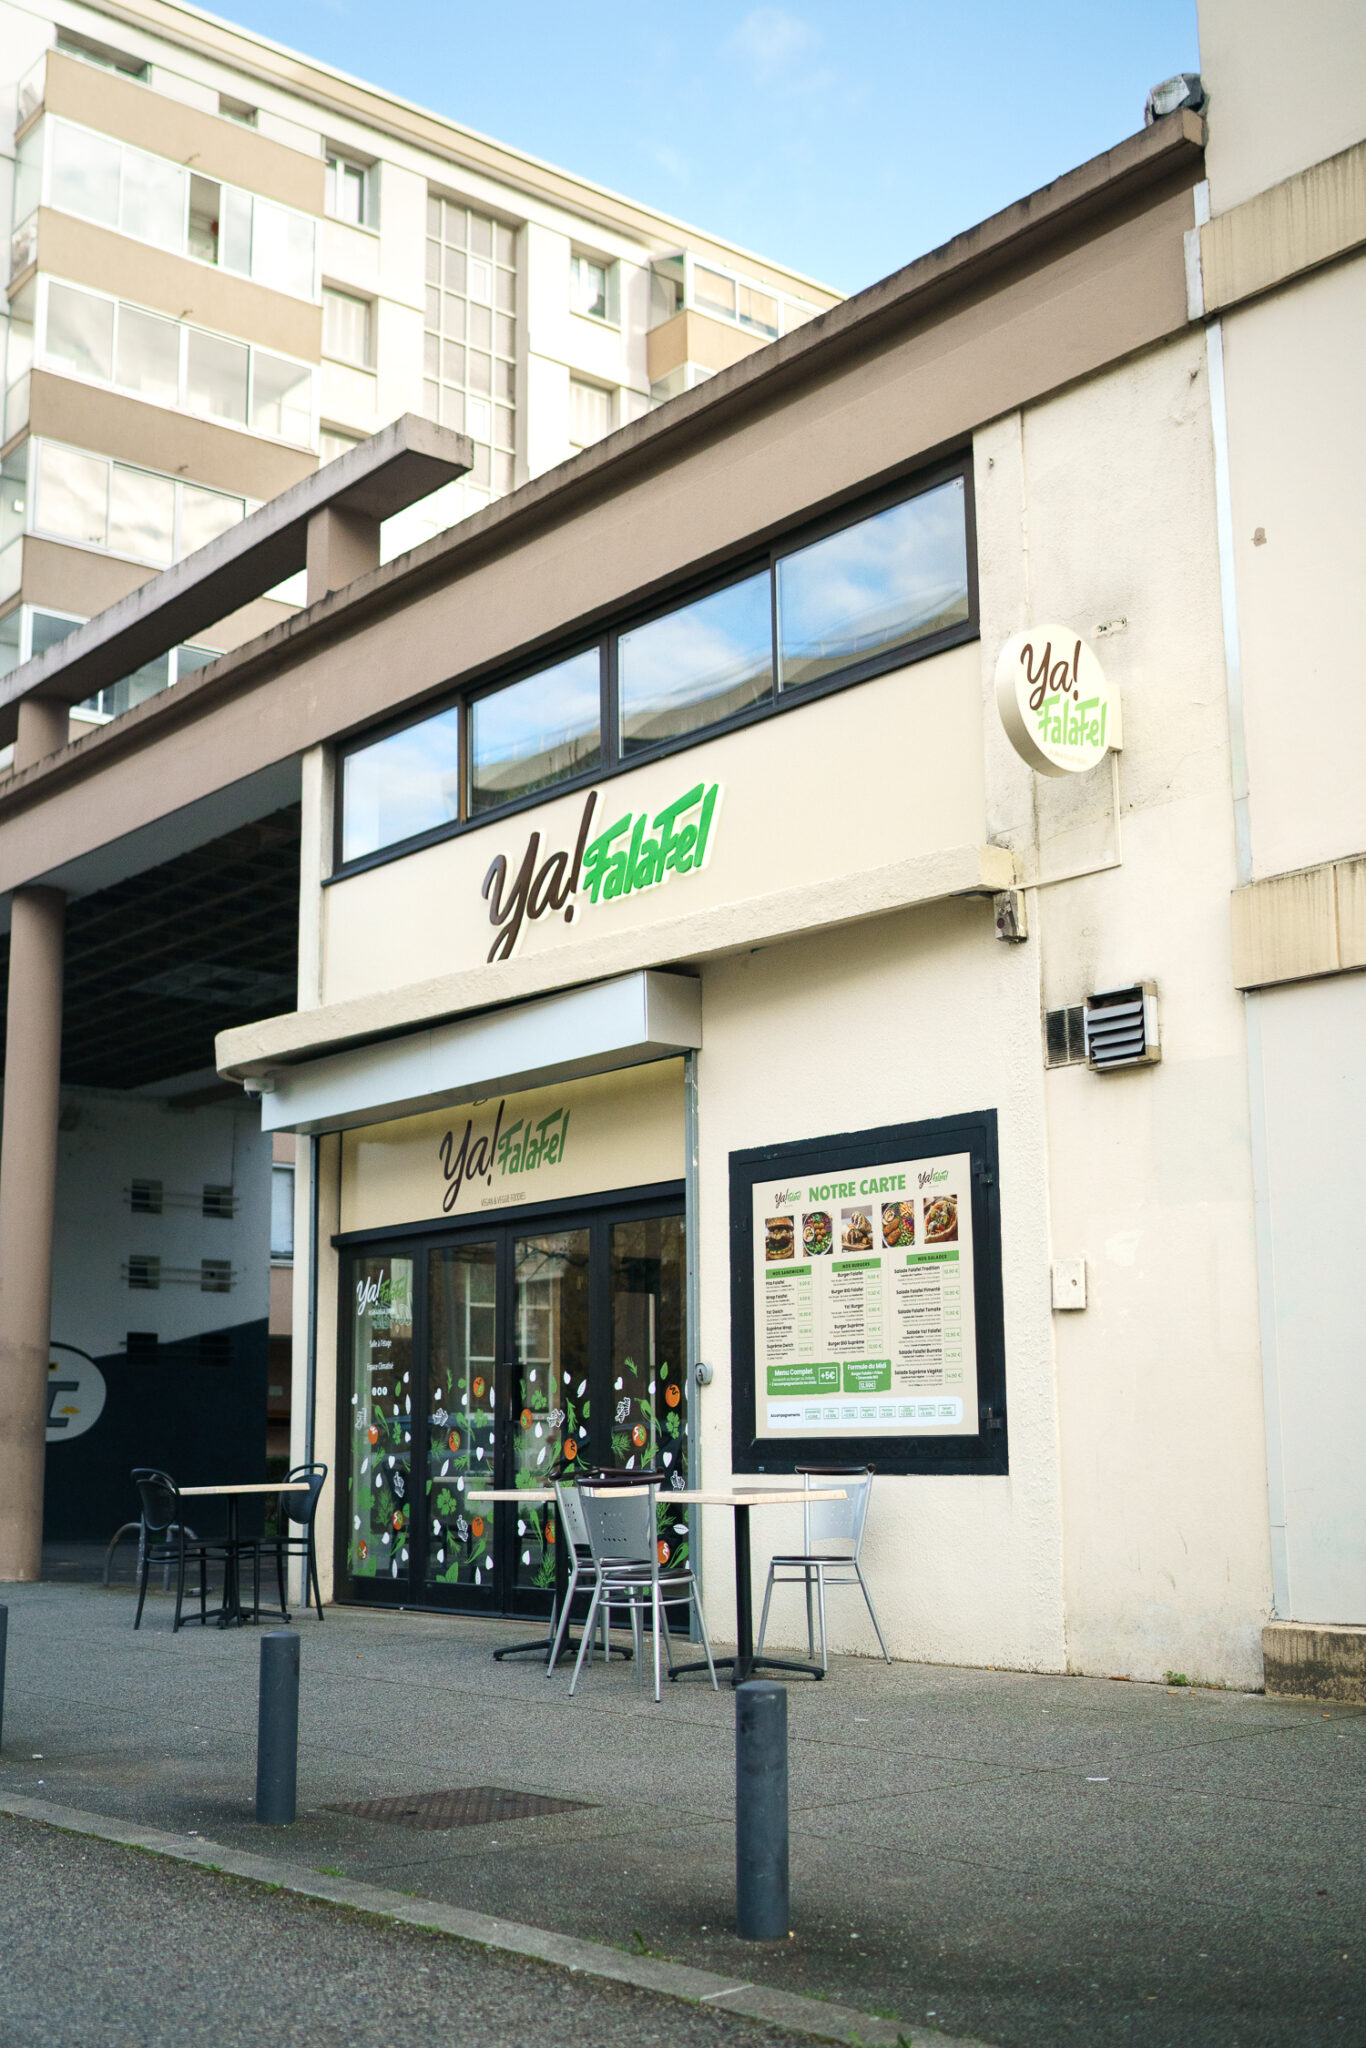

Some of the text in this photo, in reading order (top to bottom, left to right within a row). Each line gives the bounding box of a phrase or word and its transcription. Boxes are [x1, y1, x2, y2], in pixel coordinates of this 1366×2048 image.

[1020, 640, 1082, 711] Ya!
[481, 790, 598, 963] Ya!
[439, 1099, 505, 1212] Ya!
[809, 1174, 906, 1202] NOTRE CARTE
[917, 1168, 934, 1189] Ya!
[774, 1188, 789, 1208] Ya!
[356, 1269, 384, 1316] Ya!
[790, 1368, 813, 1376] Complet
